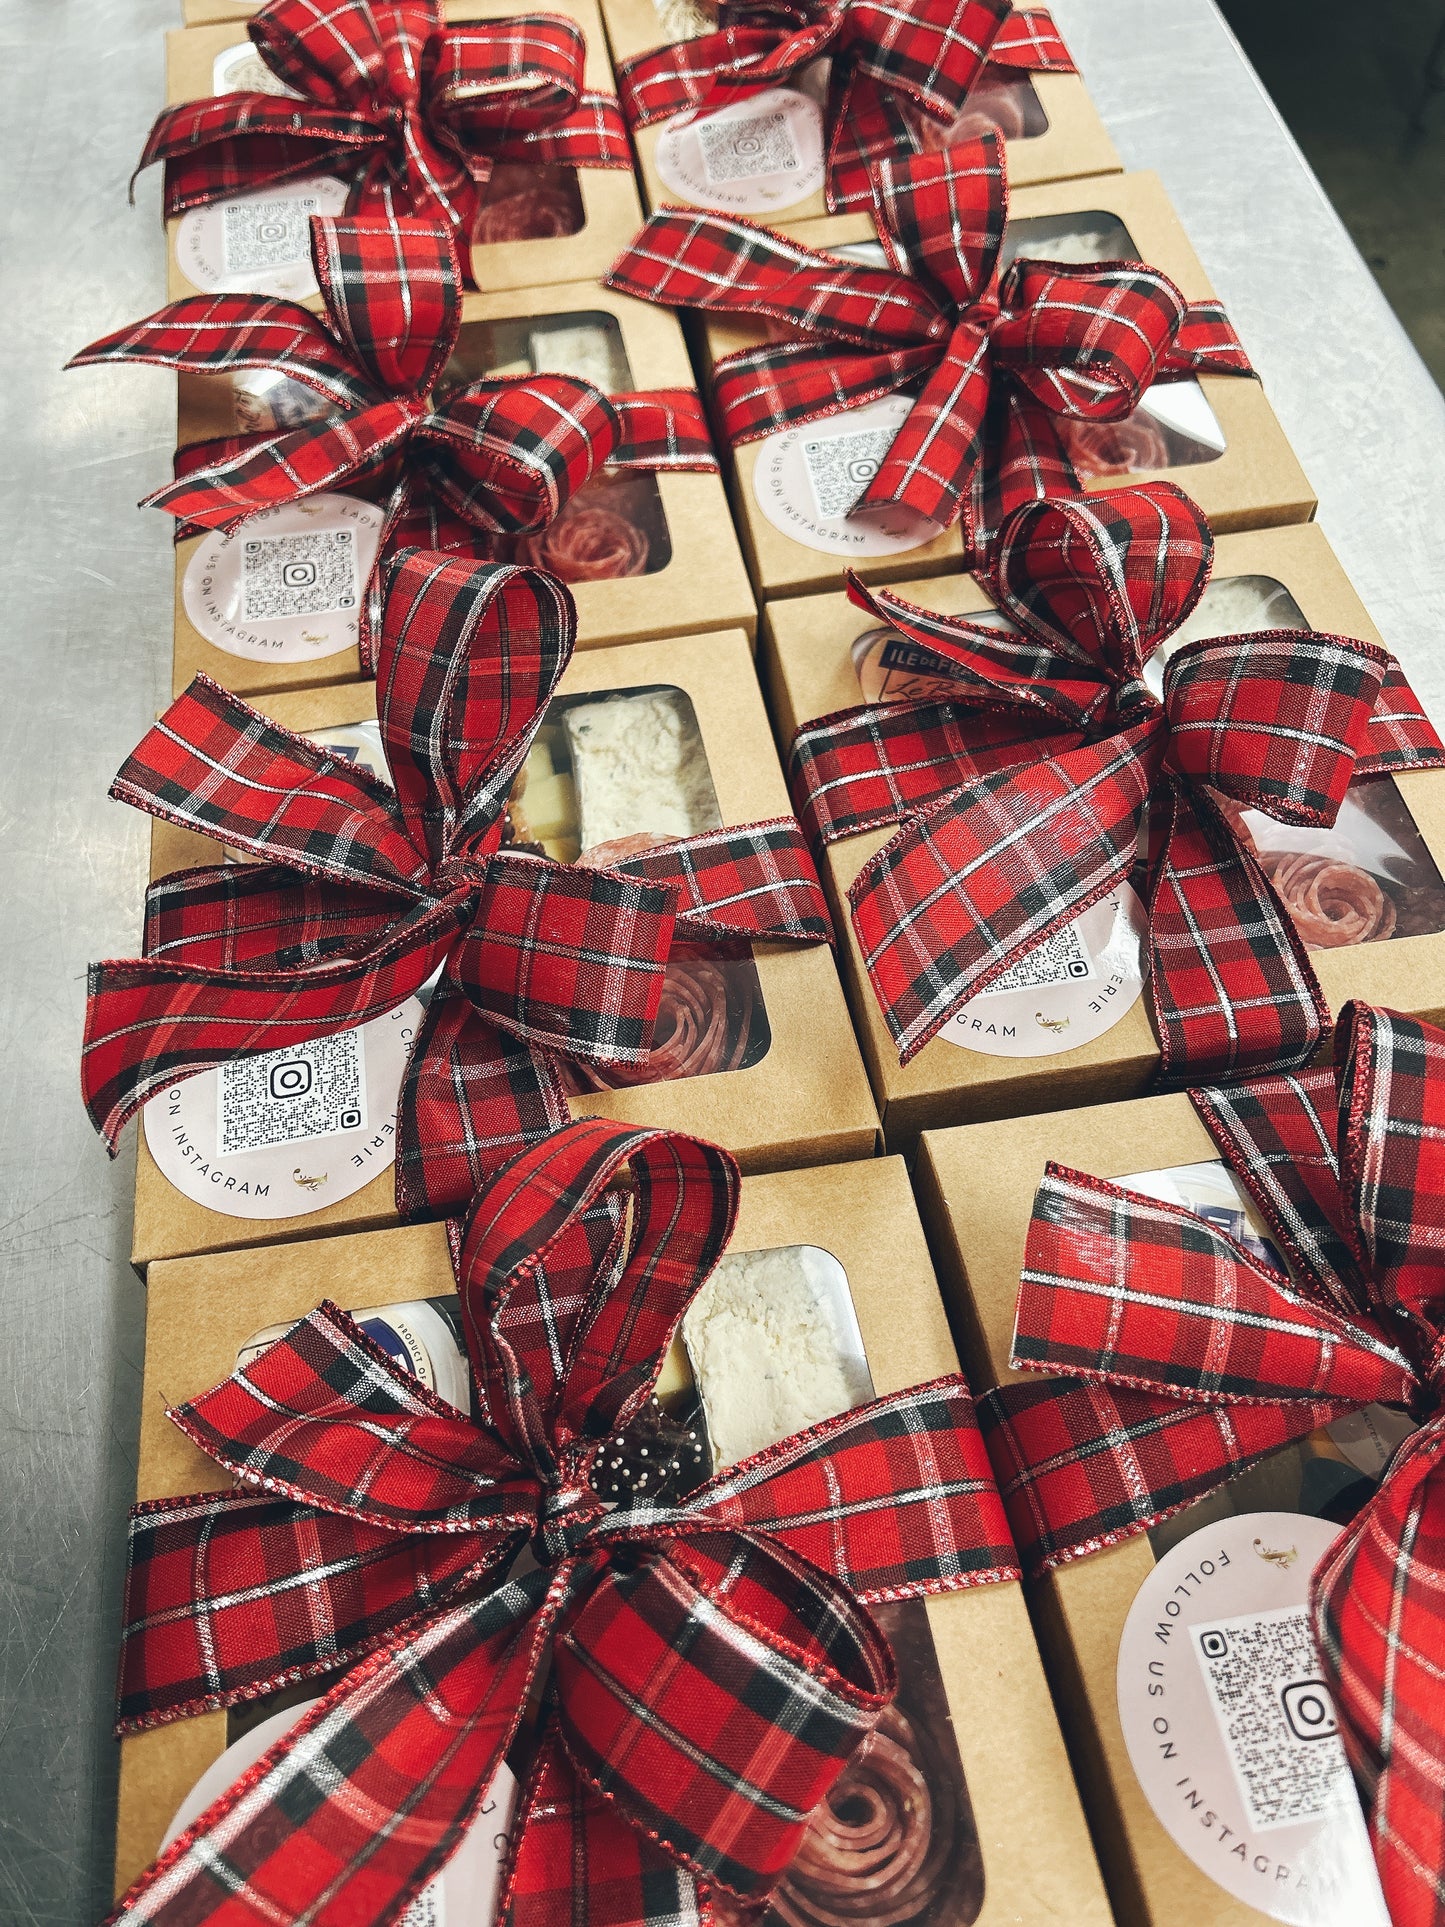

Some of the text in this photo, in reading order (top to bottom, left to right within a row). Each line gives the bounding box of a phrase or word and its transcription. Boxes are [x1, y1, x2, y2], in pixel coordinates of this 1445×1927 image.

[780, 502, 866, 544] INSTAGRAM
[201, 576, 213, 596] ON
[205, 602, 285, 649] INSTAGRAM
[889, 648, 919, 667] ILE
[391, 1011, 403, 1021] J
[169, 1089, 271, 1197] ON INSTAGRAM
[398, 1324, 426, 1380] PRODUCT OF
[1154, 1549, 1231, 1646] FOLLOW
[1148, 1661, 1165, 1697] US
[1153, 1716, 1178, 1760] ON
[481, 1801, 496, 1814] J
